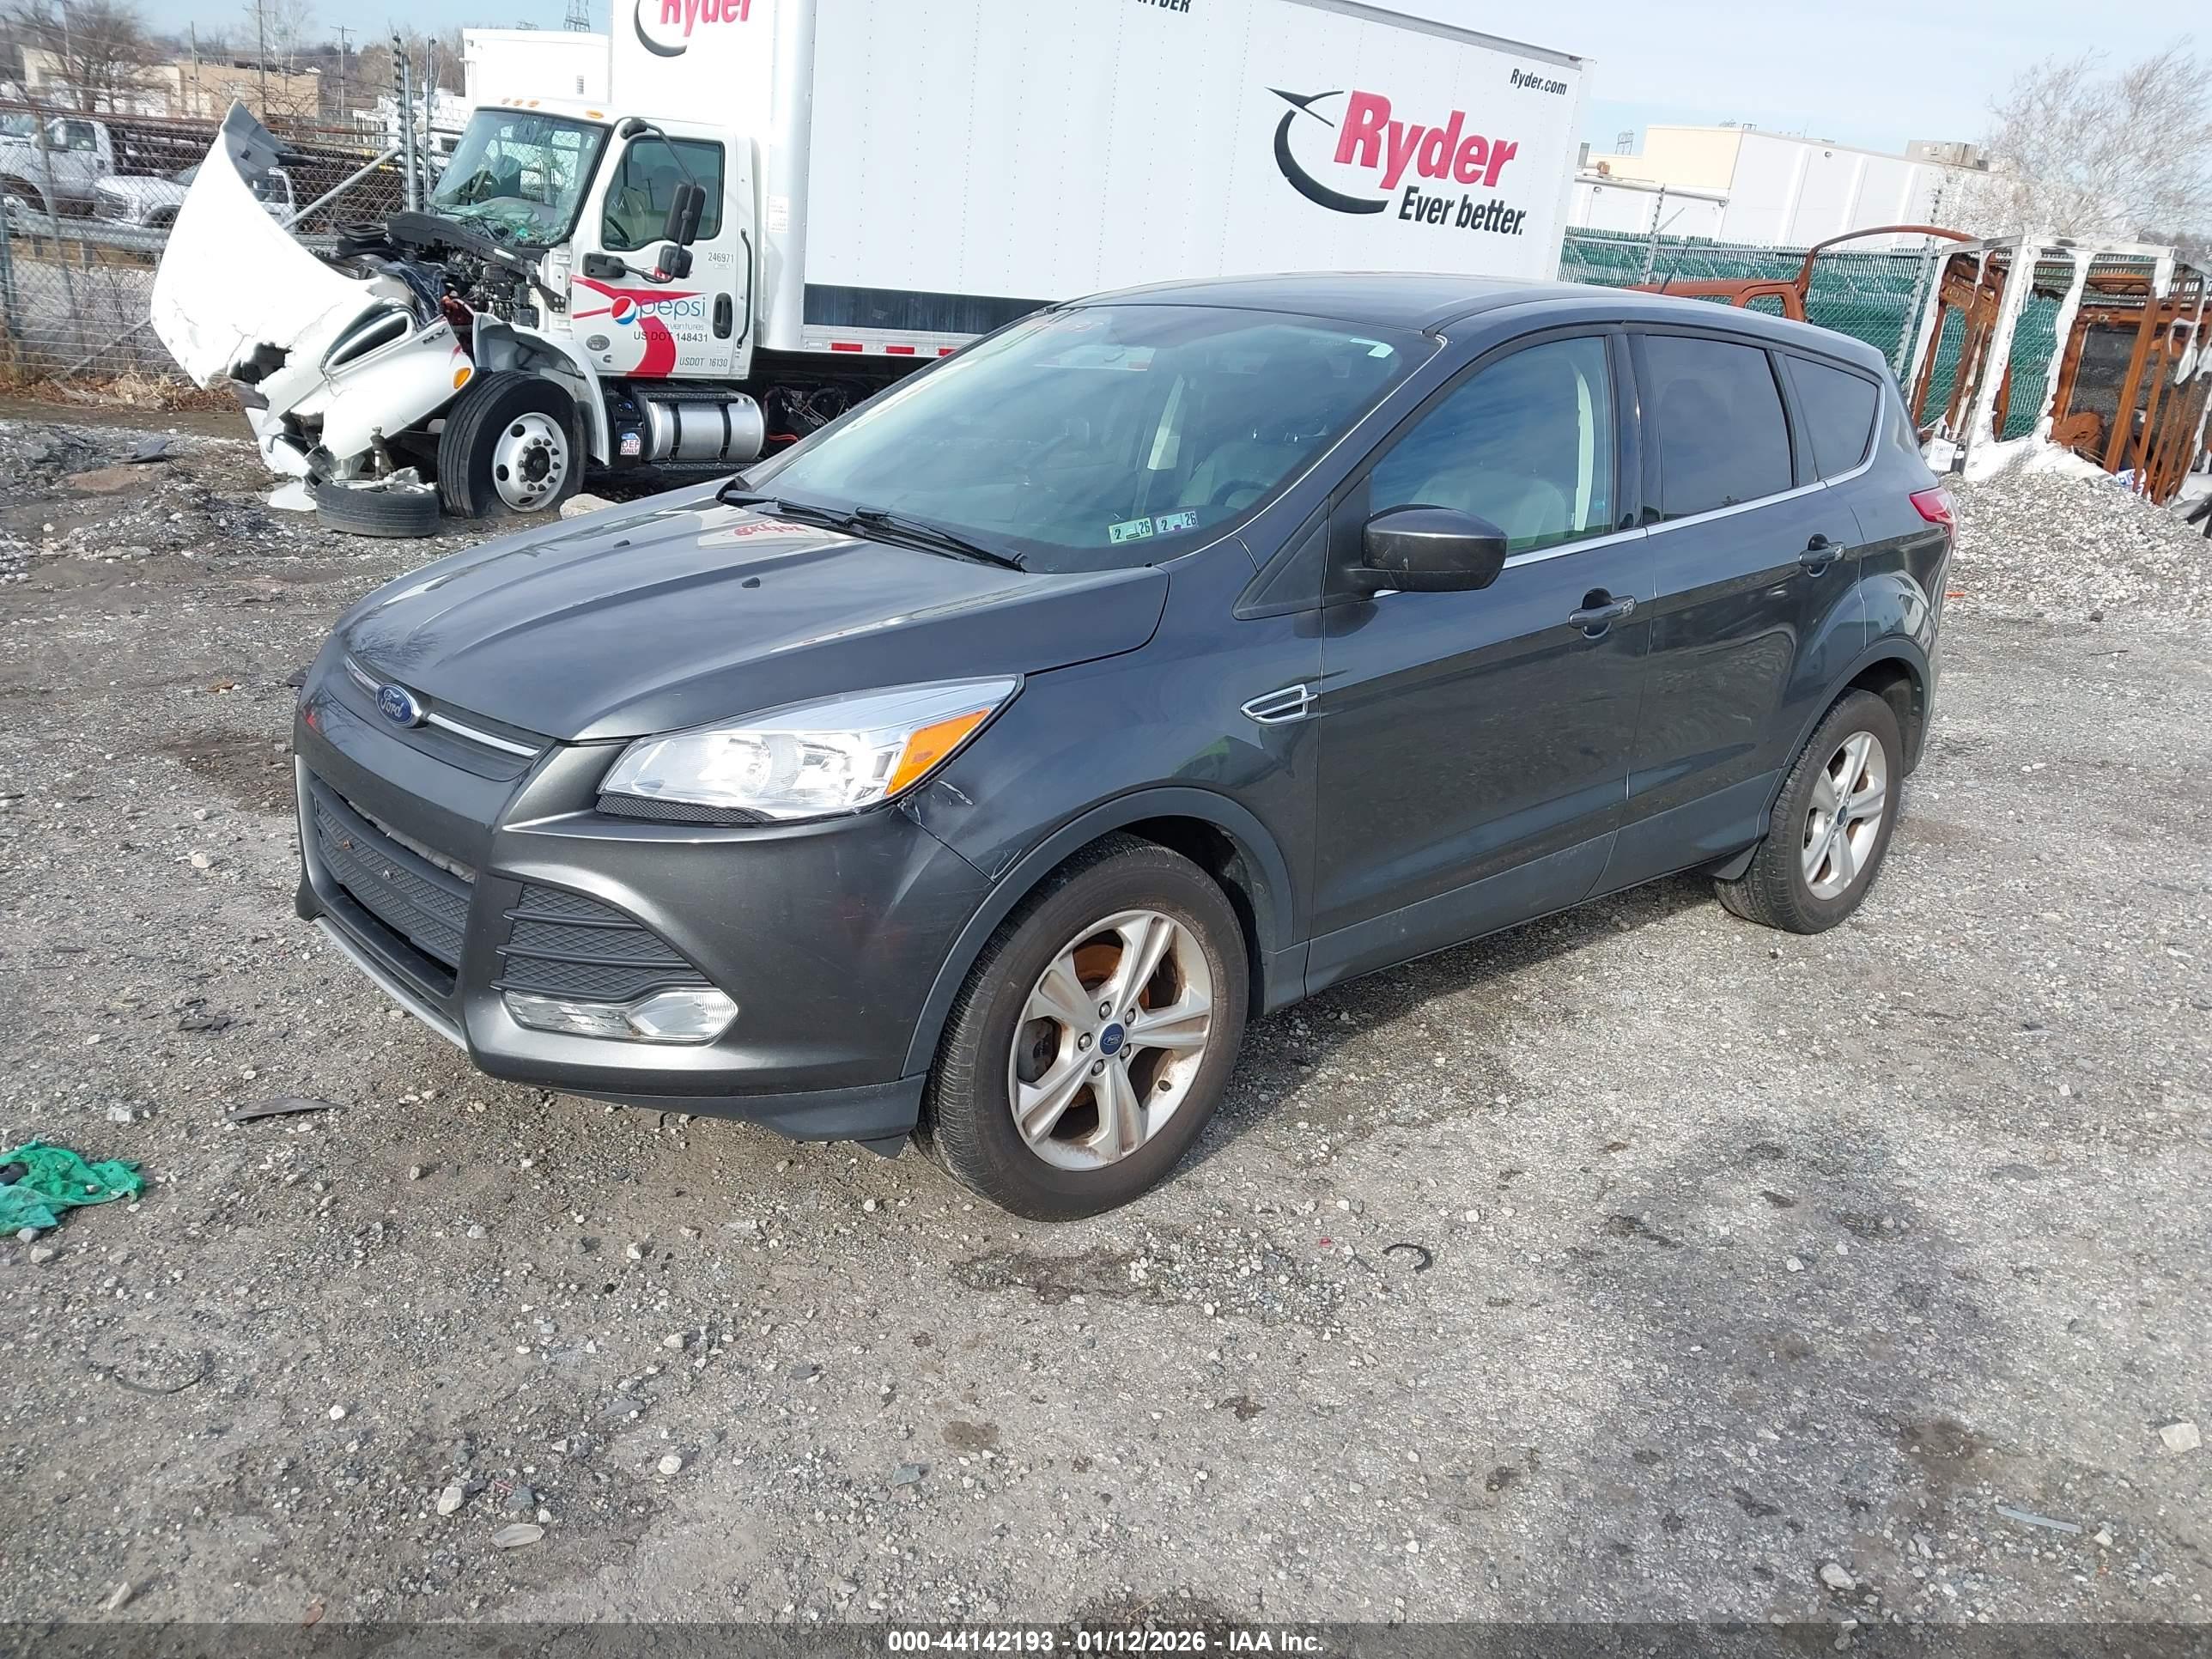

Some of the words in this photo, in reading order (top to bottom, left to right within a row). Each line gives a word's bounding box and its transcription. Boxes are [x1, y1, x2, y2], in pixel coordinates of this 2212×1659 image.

[1136, 0, 1192, 13] DER
[1510, 68, 1567, 95] Ryder.com
[1334, 89, 1519, 190] Ryder
[1398, 185, 1455, 225] Ever
[1455, 194, 1527, 235] better.
[708, 252, 734, 264] 246971
[639, 296, 706, 320] pepsi
[634, 331, 648, 341] US
[651, 331, 673, 341] DOT
[676, 332, 708, 343] 148431
[678, 356, 705, 367] USDOT
[708, 357, 729, 368] 16130
[1114, 528, 1122, 540] 2
[1139, 520, 1151, 534] 26
[1161, 520, 1169, 531] 2
[1185, 512, 1196, 526] 26
[380, 689, 405, 718] Ford
